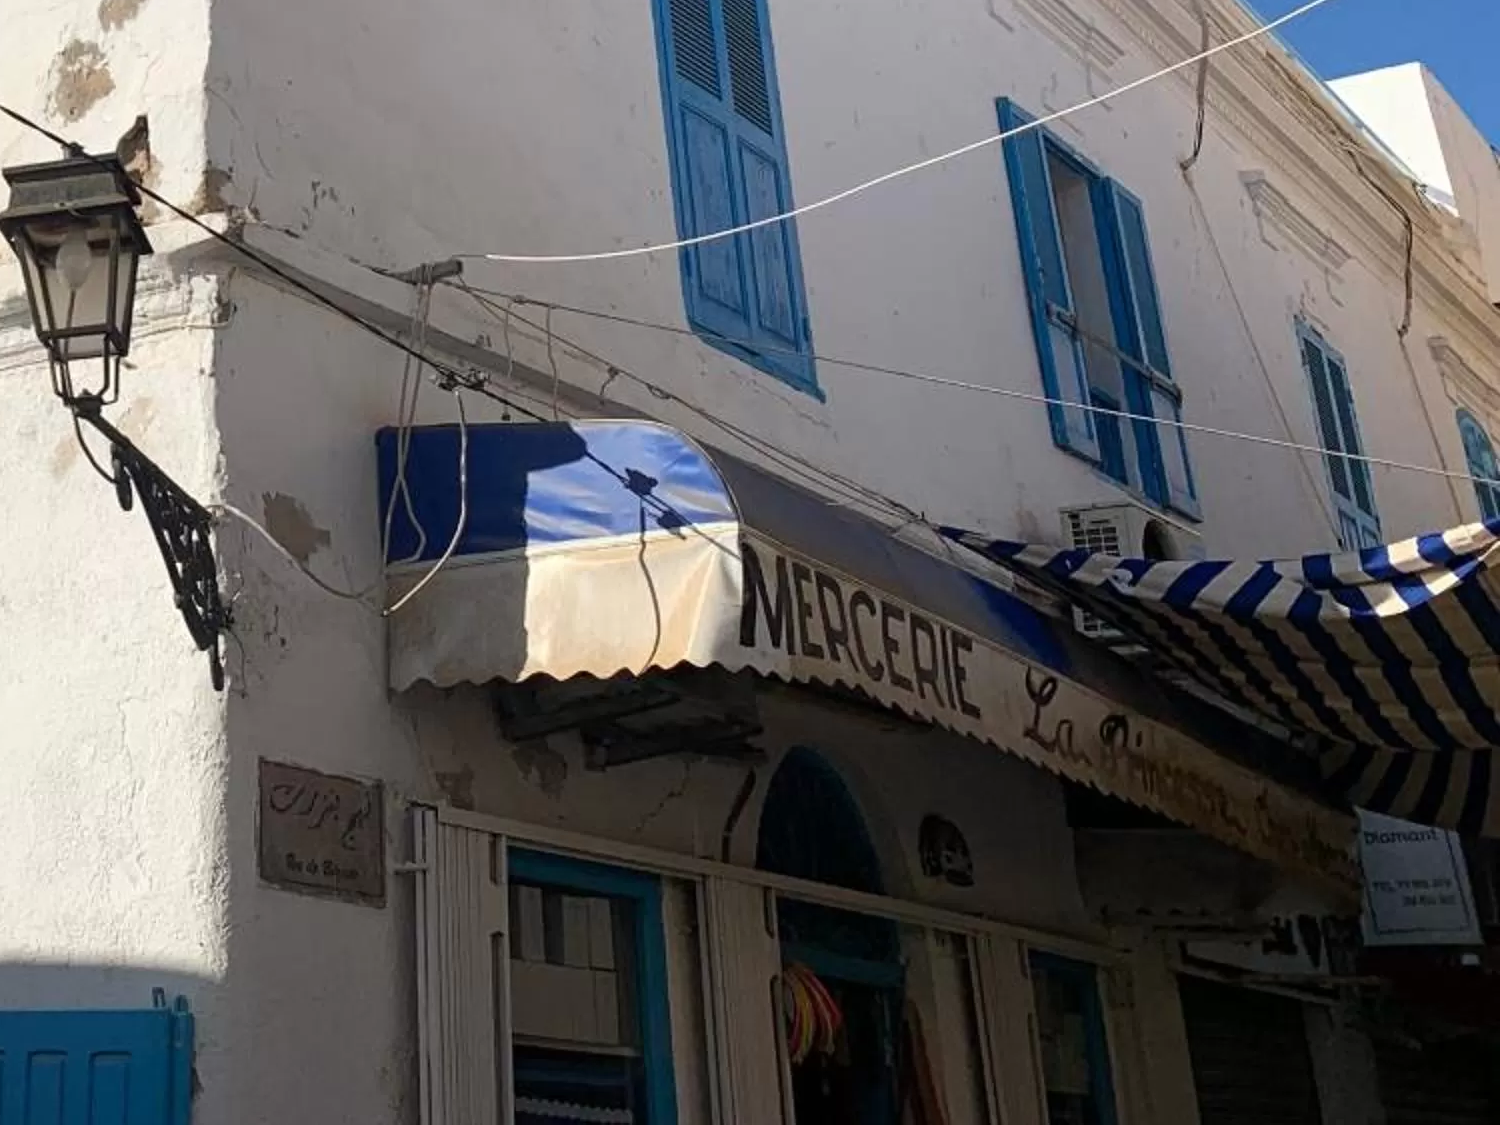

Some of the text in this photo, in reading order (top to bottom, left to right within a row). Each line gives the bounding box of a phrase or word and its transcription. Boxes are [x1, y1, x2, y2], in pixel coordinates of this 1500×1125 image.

[739, 541, 980, 719] MERCERIE
[1023, 664, 1091, 765] La
[1363, 829, 1440, 845] Diamant
